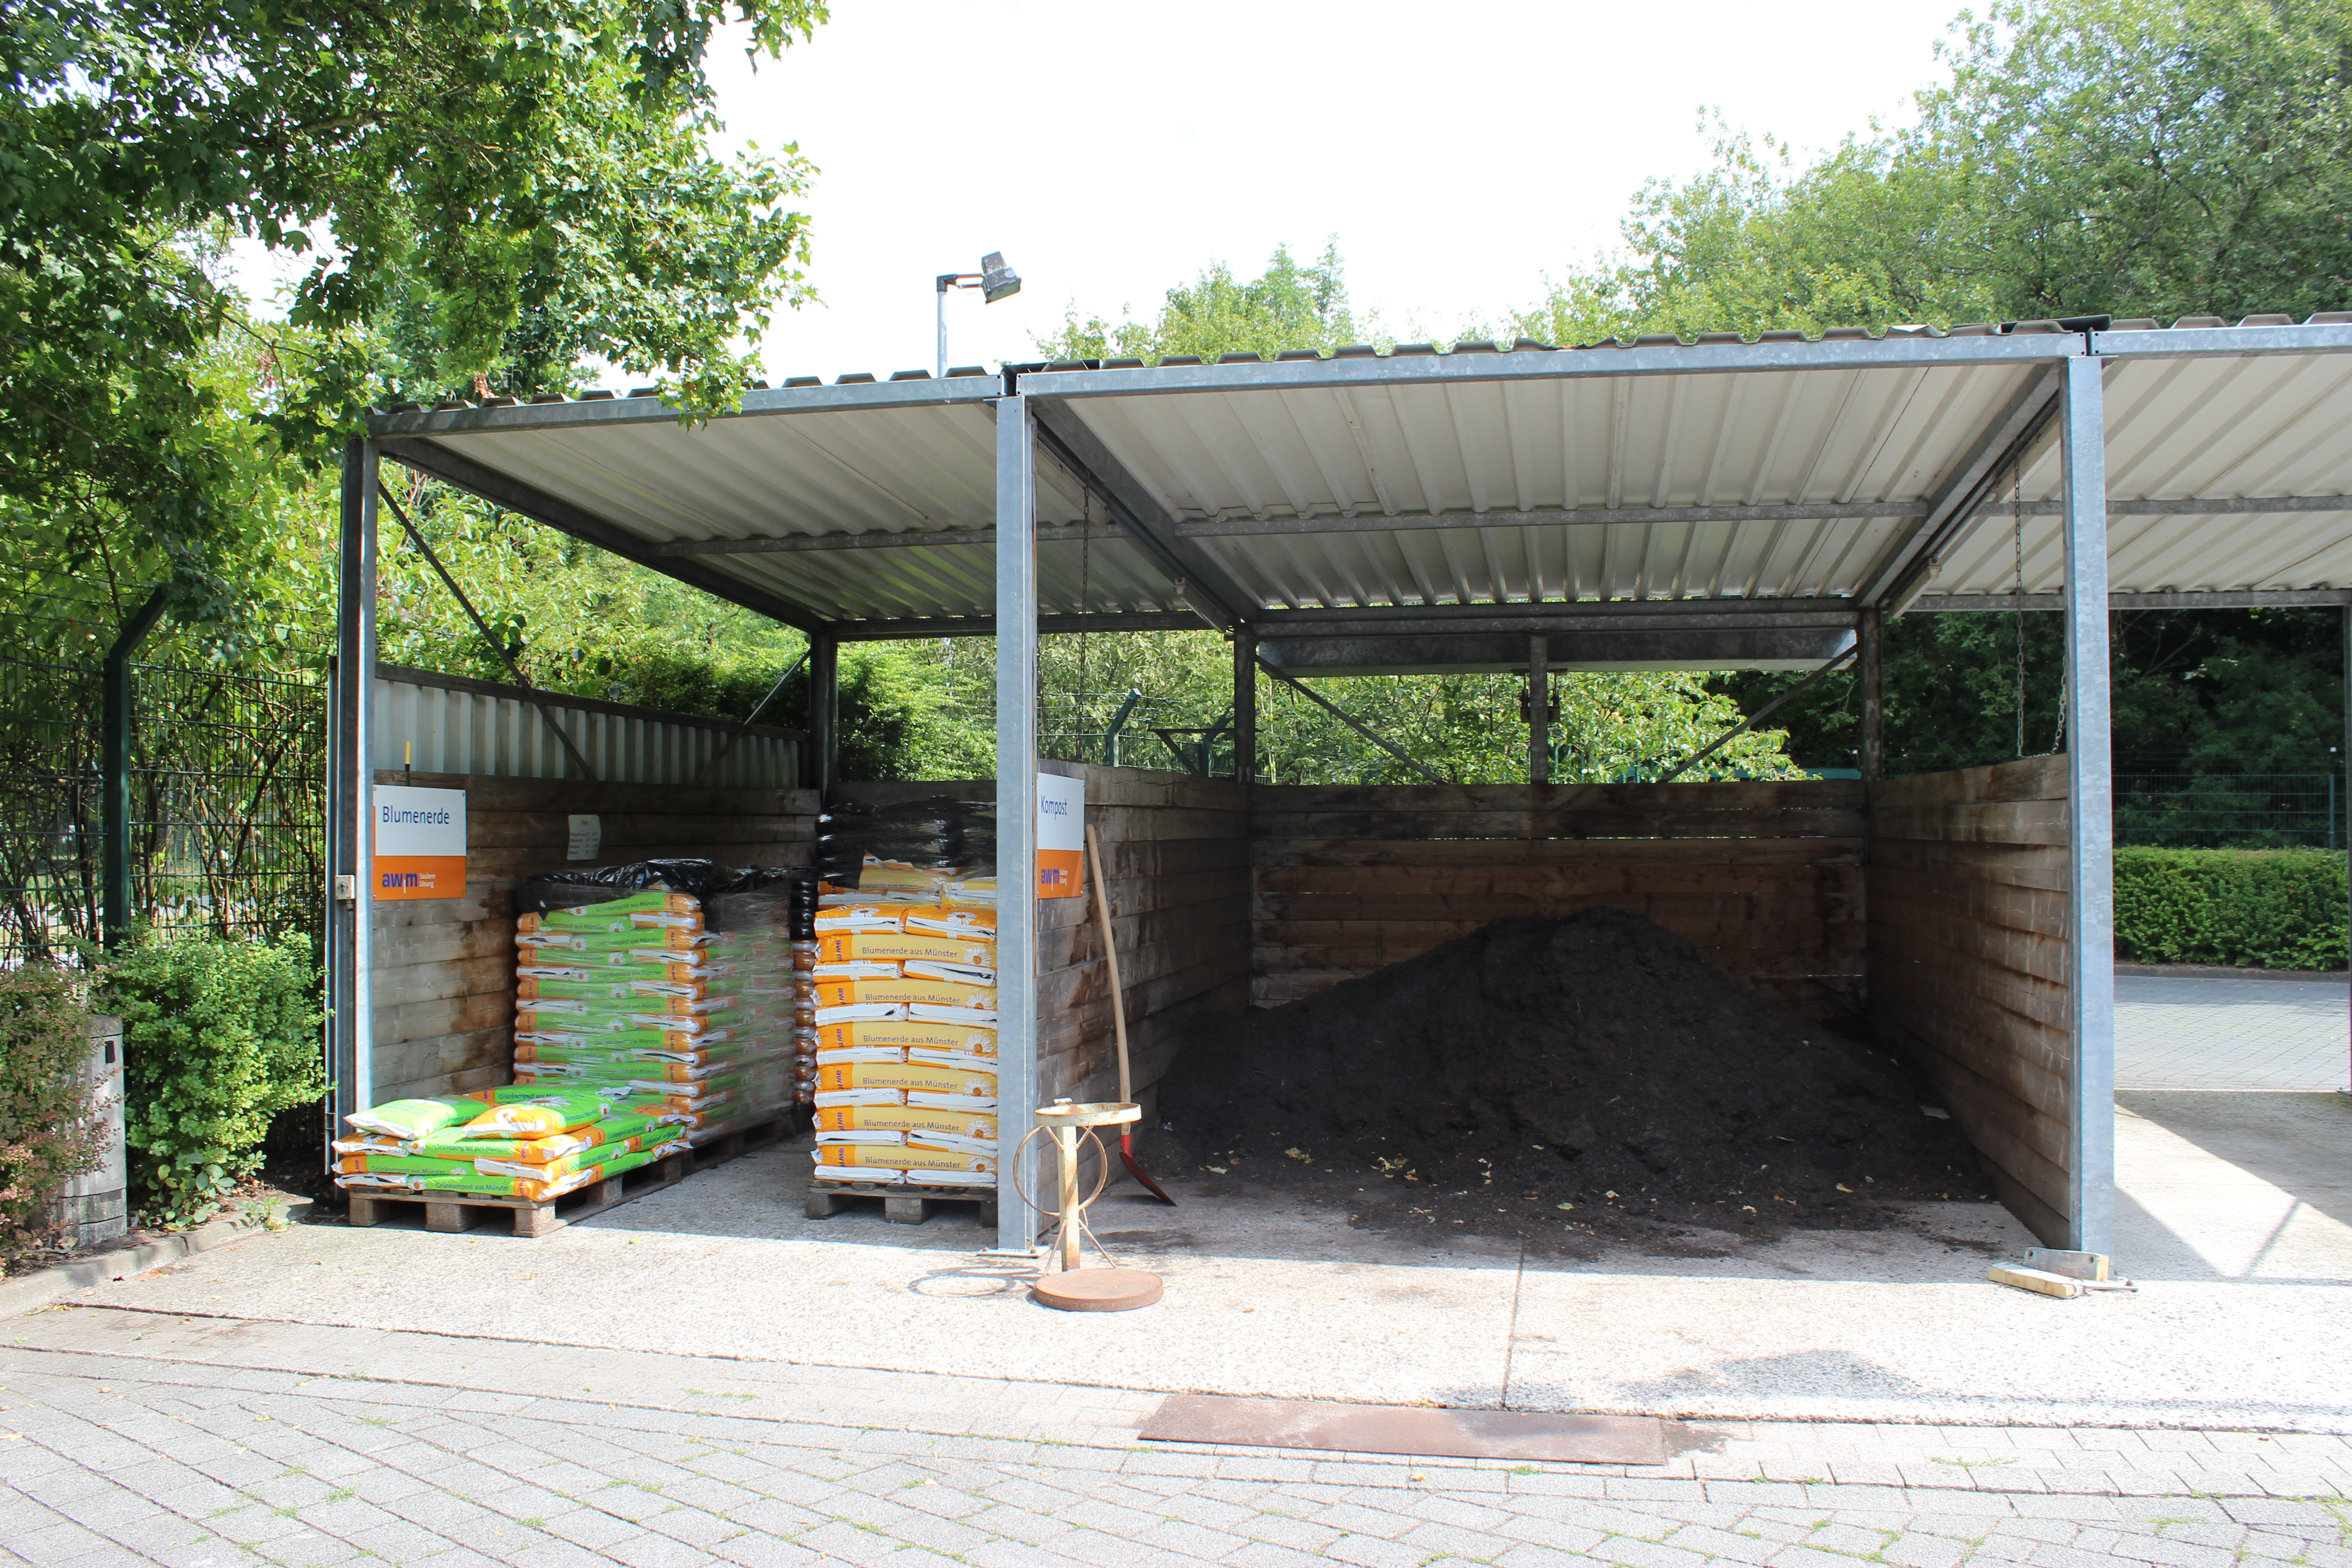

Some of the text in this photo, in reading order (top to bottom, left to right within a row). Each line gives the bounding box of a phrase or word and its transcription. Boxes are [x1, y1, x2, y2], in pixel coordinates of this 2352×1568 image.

[1041, 795, 1067, 820] Kompost
[382, 805, 450, 824] Blumenerde
[382, 873, 418, 888] awm
[419, 880, 435, 888] Lösung
[596, 903, 629, 911] Grünkompost
[925, 948, 957, 958] Münster
[928, 994, 960, 1004] Münster
[926, 1037, 959, 1046] Münster
[925, 1079, 958, 1089] Münster
[927, 1122, 960, 1131] Münster
[865, 1156, 911, 1165] Blumenerde
[928, 1159, 960, 1168] Münster
[436, 1183, 473, 1191] Grünkompost
